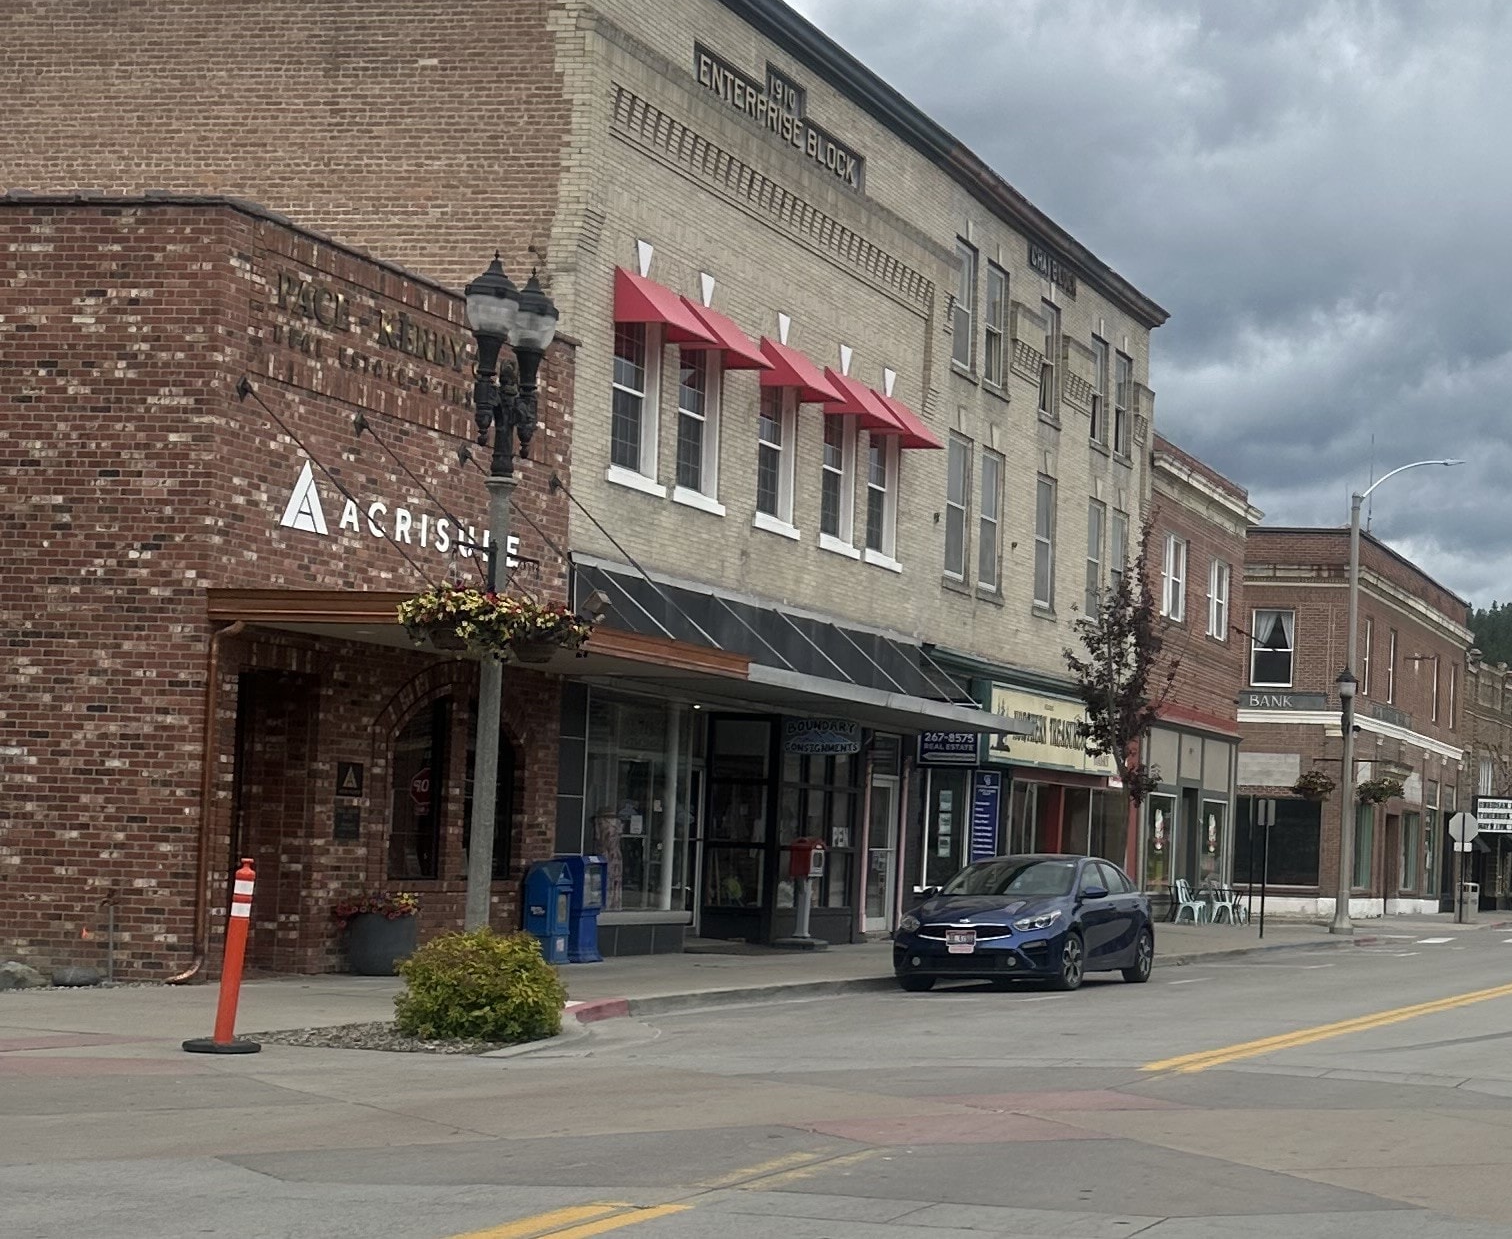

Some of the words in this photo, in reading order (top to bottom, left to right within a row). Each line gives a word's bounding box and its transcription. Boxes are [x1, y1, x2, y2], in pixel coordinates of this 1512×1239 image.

[769, 74, 796, 109] 1910
[699, 53, 804, 149] ENTERPRISE
[806, 127, 857, 188] BLOCK
[1249, 694, 1294, 707] BANK
[786, 720, 856, 733] BOUNDARY
[924, 732, 975, 743] 267-8575
[784, 742, 858, 753] CONSIGNMENTS
[945, 743, 975, 751] ESTATE
